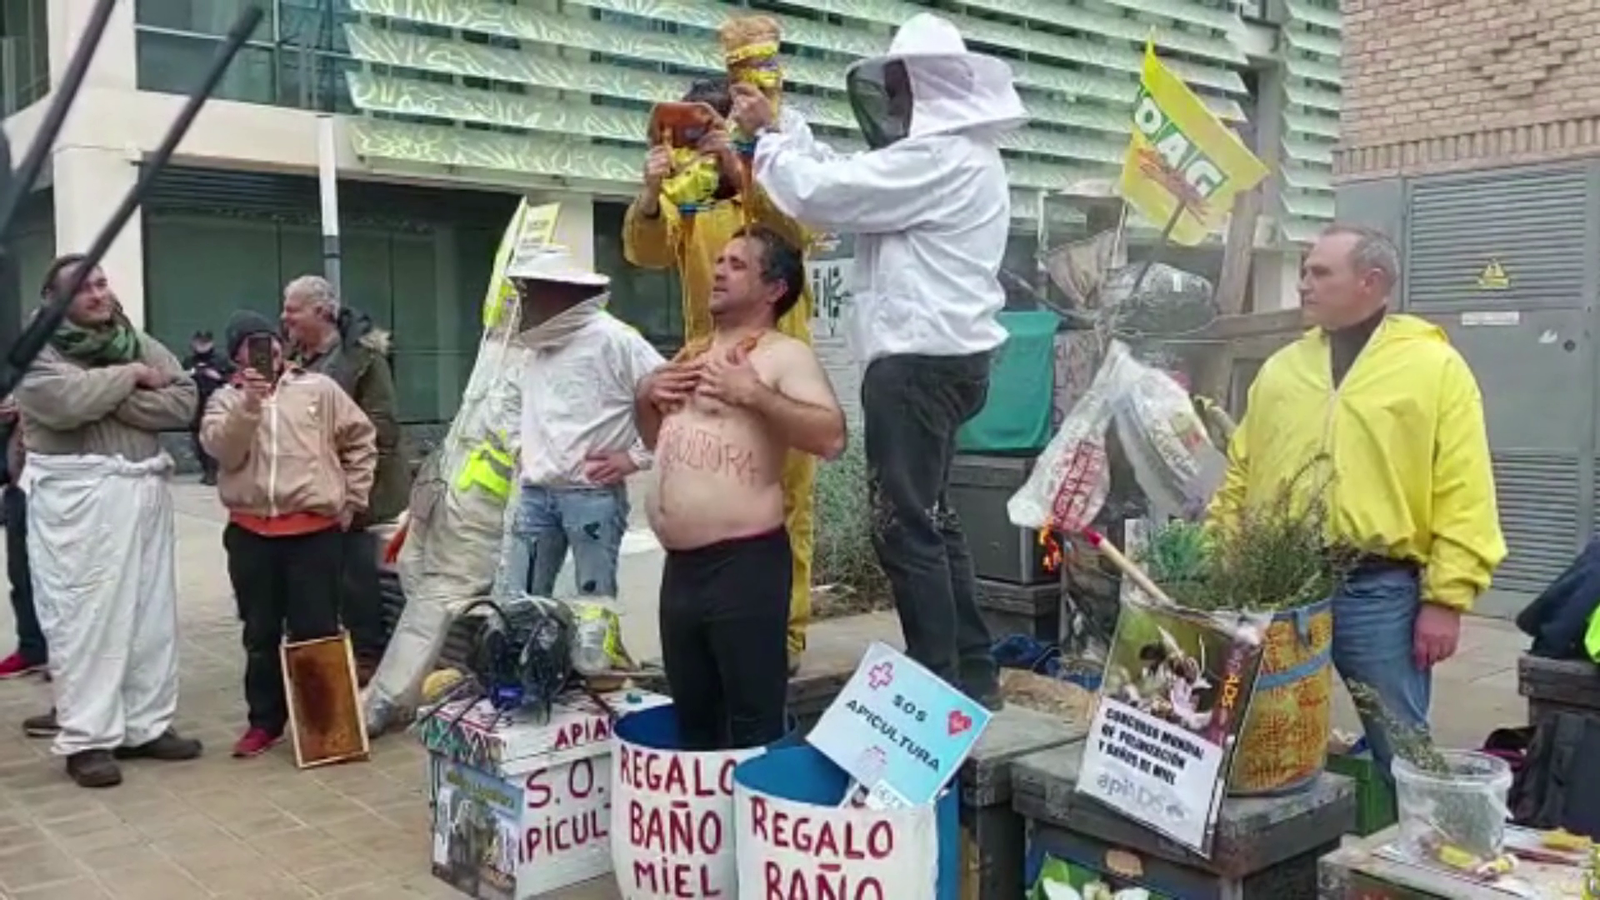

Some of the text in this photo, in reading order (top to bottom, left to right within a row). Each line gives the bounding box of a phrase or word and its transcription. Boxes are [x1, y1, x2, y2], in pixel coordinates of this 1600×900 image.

[1134, 82, 1224, 197] OAG
[555, 716, 614, 748] APIA
[846, 699, 940, 773] APICULTURA
[892, 694, 929, 723] SOS
[620, 743, 738, 797] REGALO
[1160, 731, 1205, 761] MUNDIAL
[518, 802, 612, 864] PICUL
[629, 800, 722, 855] BAÑO
[750, 795, 894, 860] REGALO
